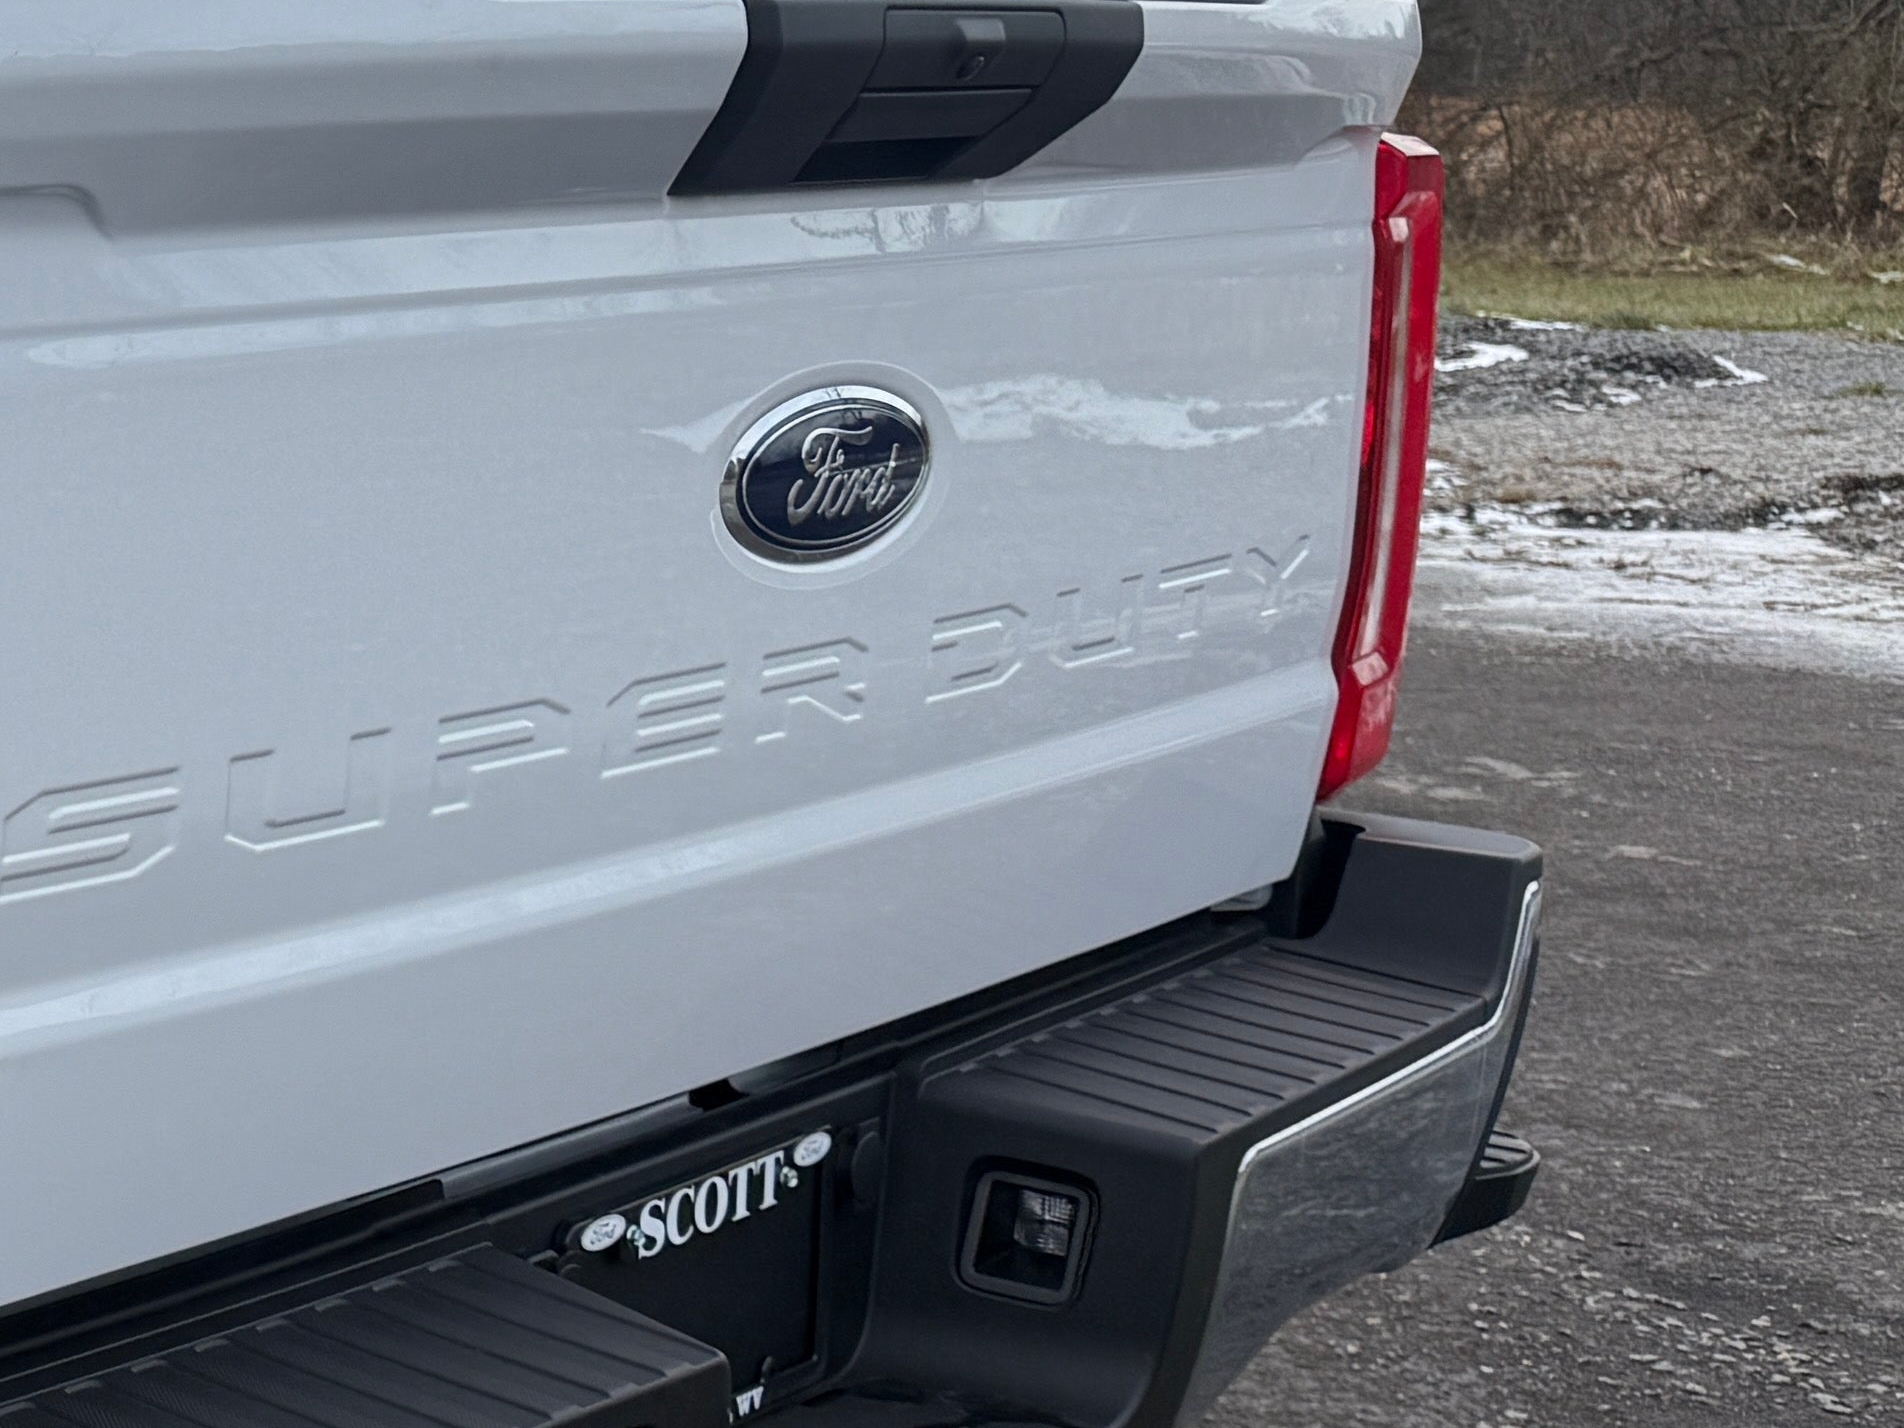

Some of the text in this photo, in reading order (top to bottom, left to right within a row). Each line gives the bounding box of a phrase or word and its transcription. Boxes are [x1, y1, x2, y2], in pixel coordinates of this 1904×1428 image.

[787, 426, 900, 526] Ford
[926, 534, 1310, 704] DUTY
[638, 1150, 784, 1259] SCOTT
